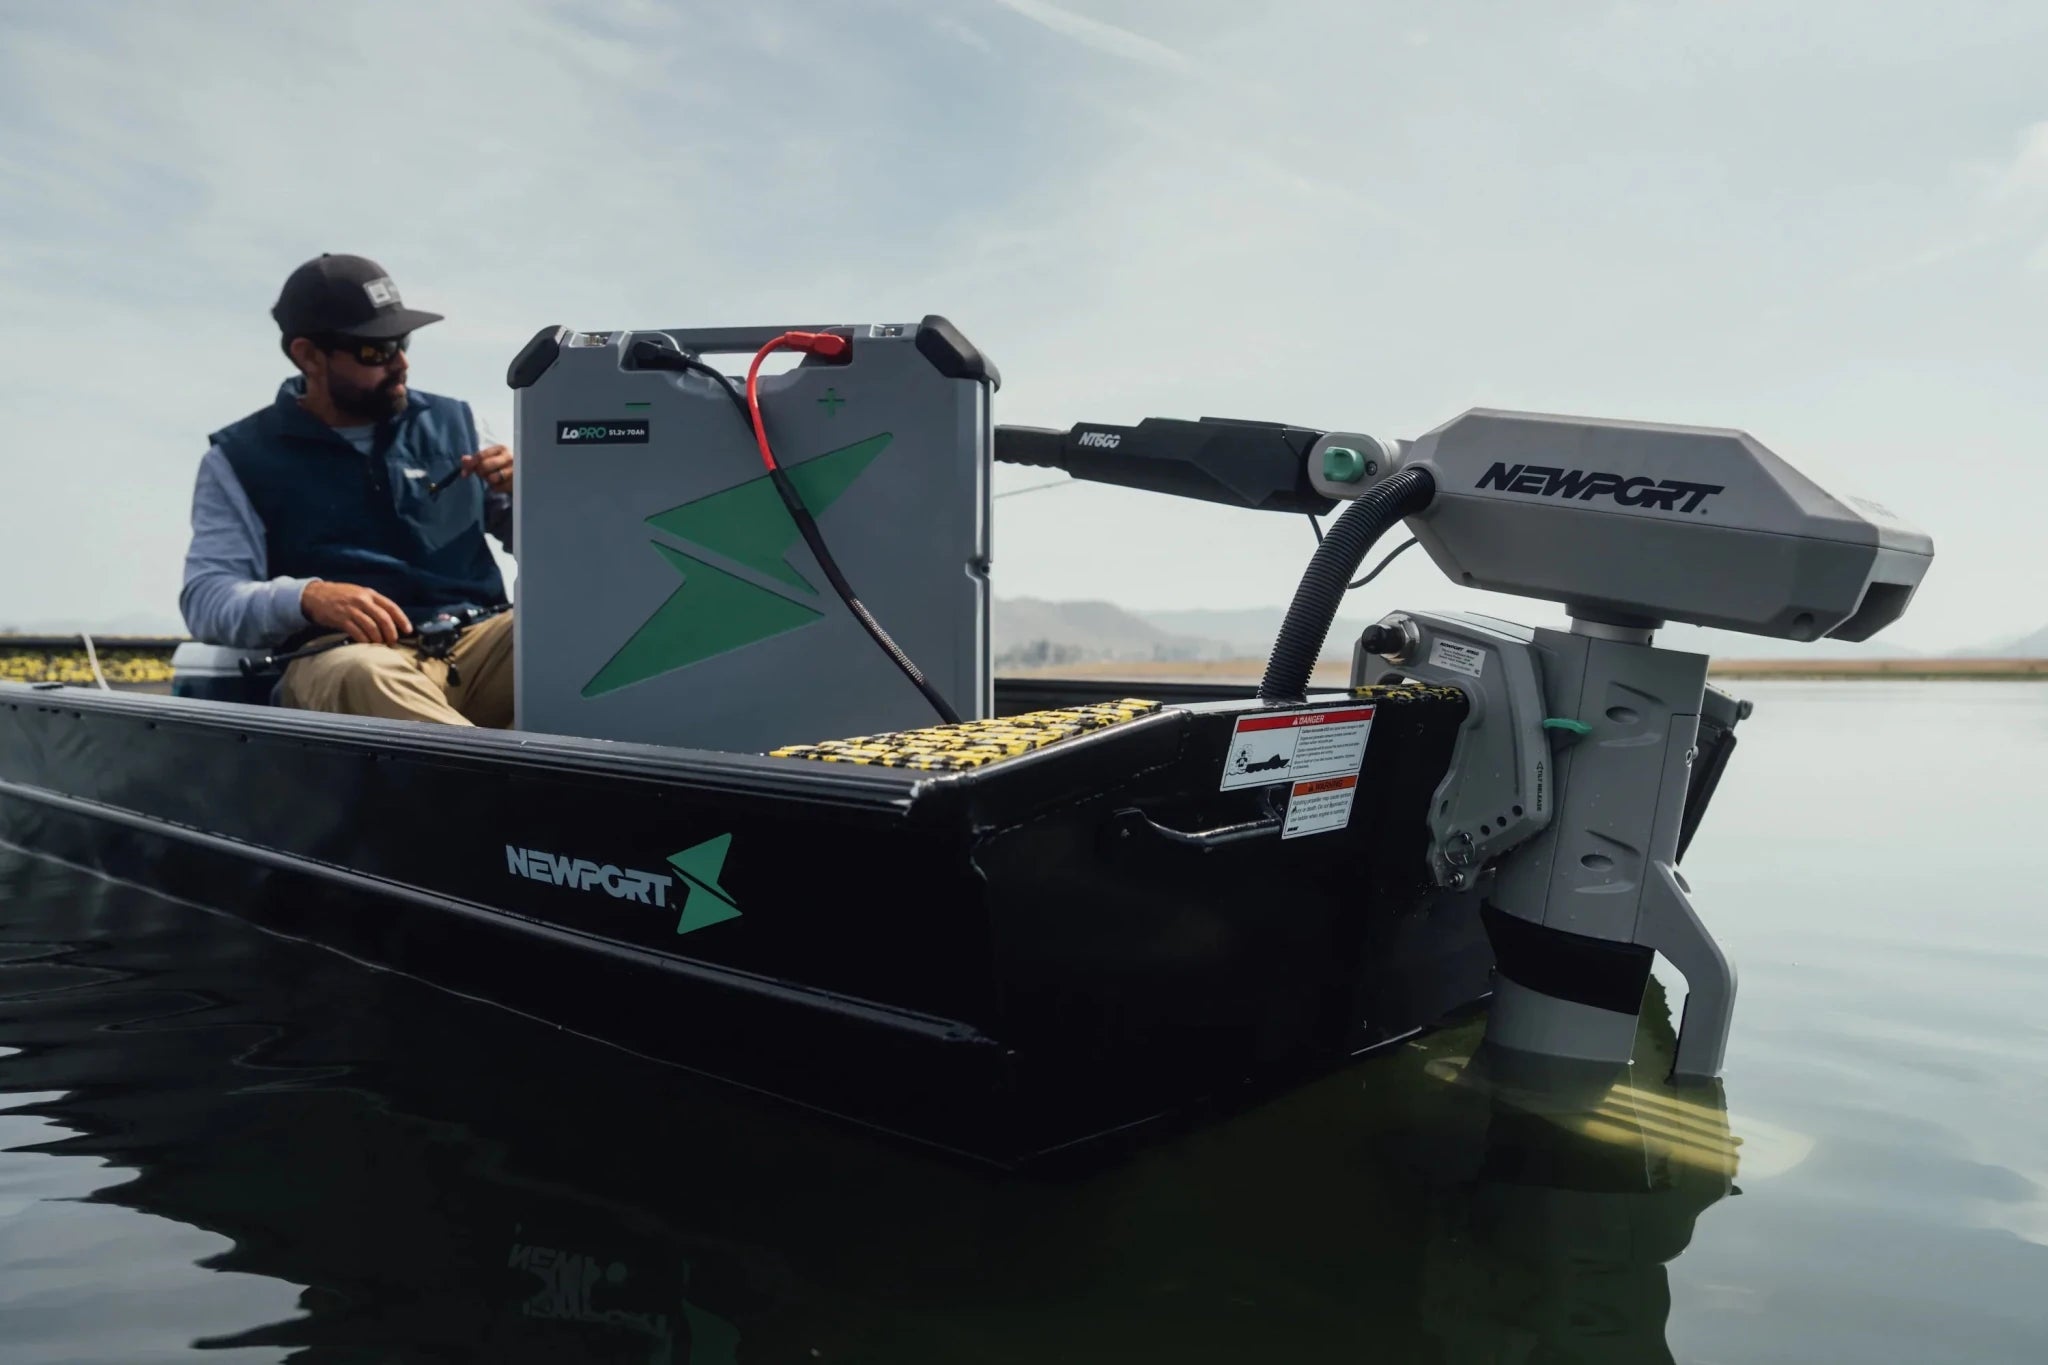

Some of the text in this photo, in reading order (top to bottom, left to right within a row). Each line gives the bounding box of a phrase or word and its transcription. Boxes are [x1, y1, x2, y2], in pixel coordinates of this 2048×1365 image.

[561, 427, 607, 440] LoPRO
[627, 428, 645, 437] 70Ah
[1474, 462, 1725, 513] NEWPORT
[1299, 714, 1325, 725] DANGER
[506, 844, 672, 907] NEWPORT
